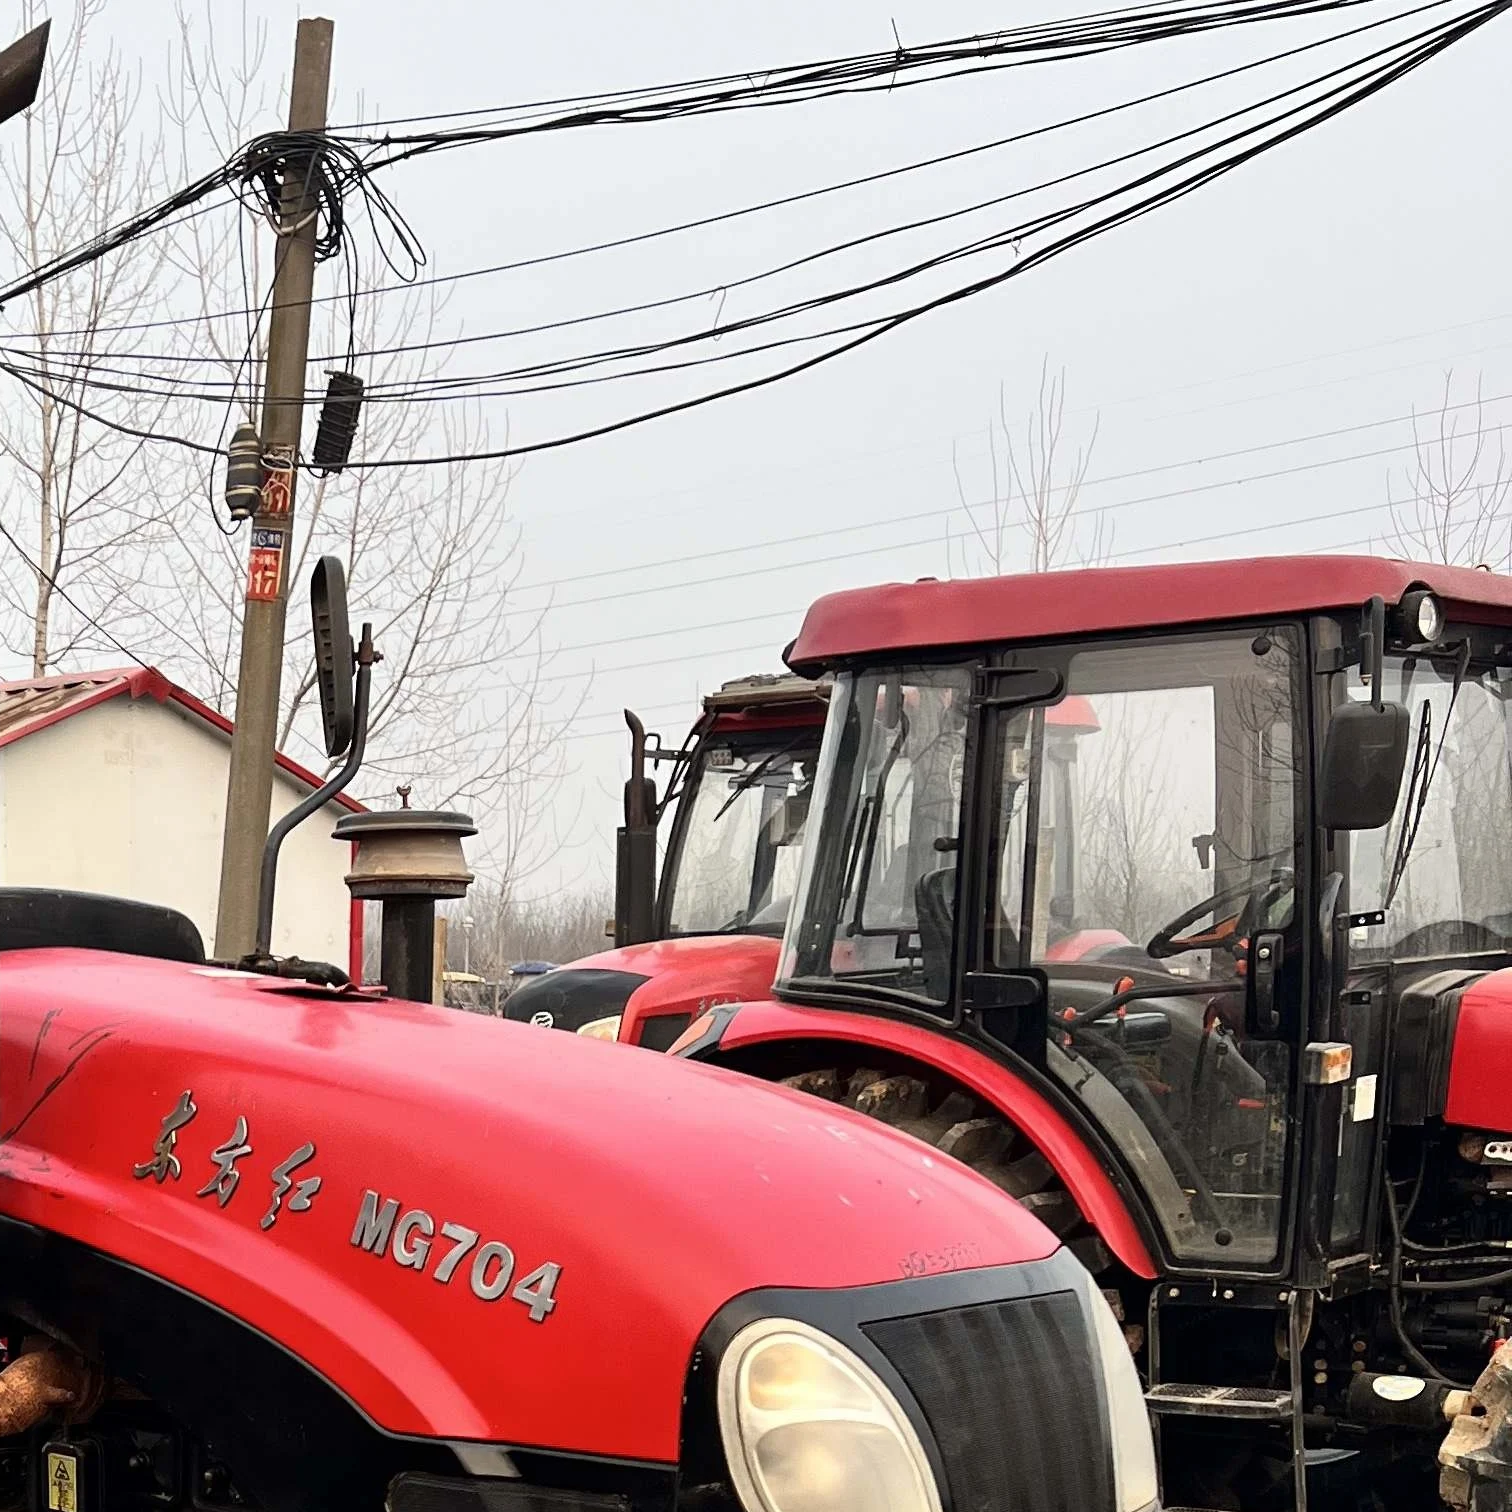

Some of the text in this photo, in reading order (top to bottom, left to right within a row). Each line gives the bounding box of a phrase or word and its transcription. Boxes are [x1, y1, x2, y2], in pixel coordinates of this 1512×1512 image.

[133, 1089, 564, 1323] 东方红 MG704
